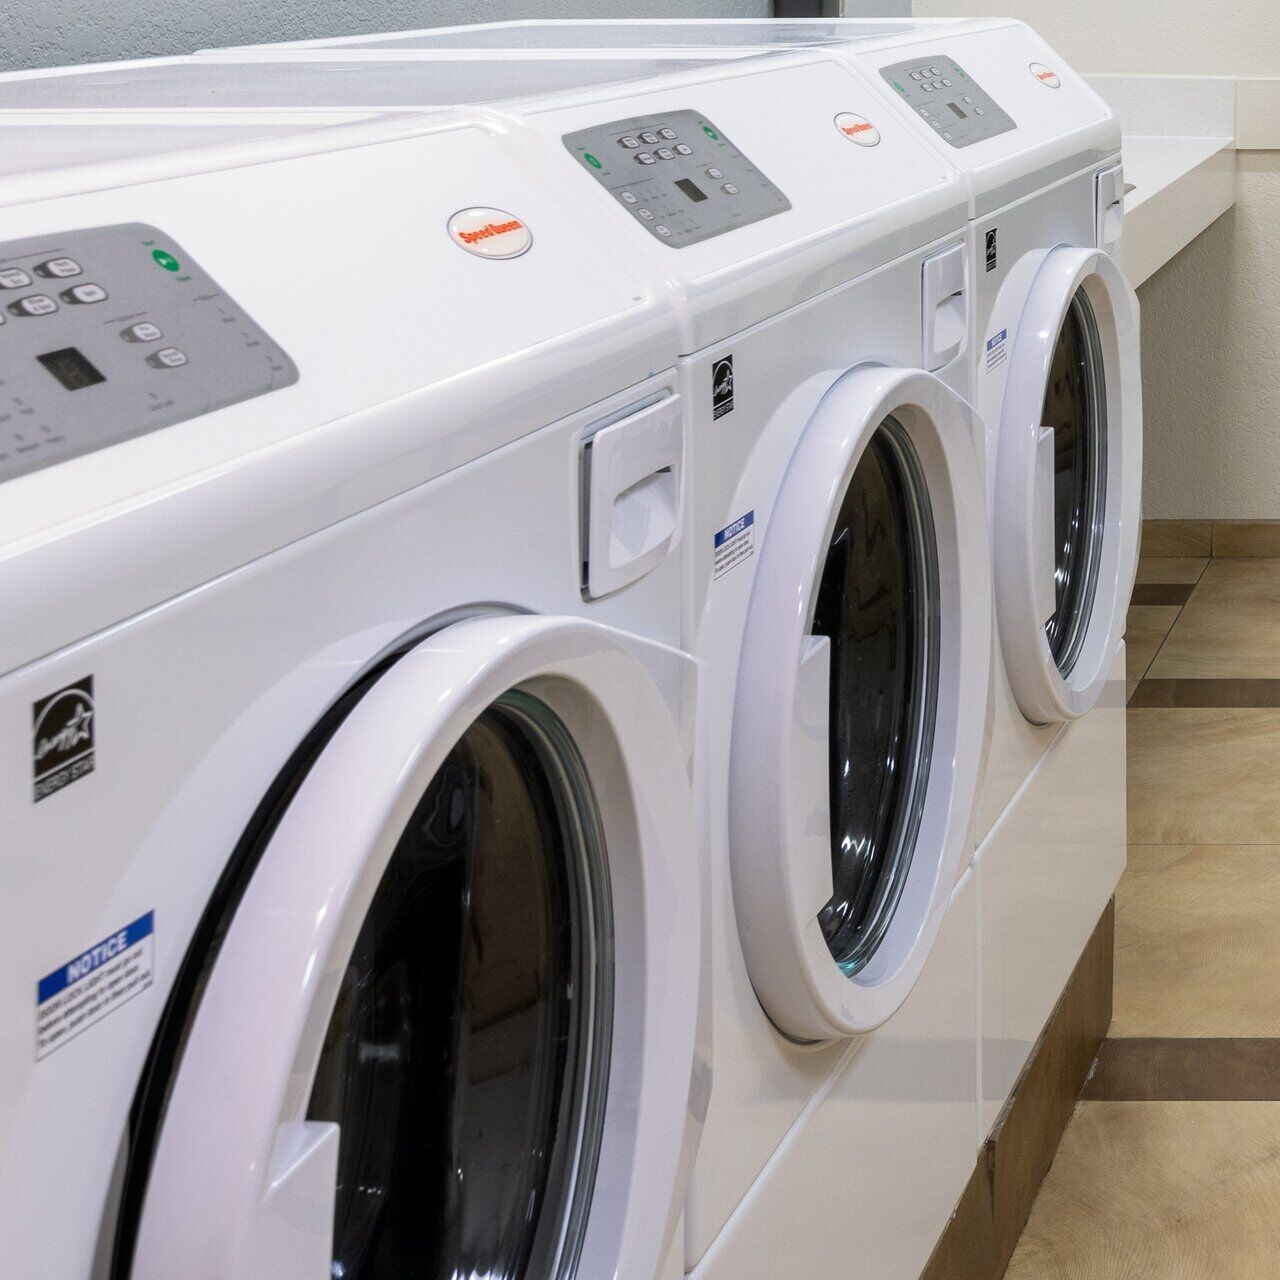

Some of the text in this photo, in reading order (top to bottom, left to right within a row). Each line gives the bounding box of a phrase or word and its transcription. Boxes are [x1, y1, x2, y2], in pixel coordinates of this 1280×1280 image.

[459, 220, 523, 244] Speed Queen
[724, 517, 745, 541] NOTICE
[66, 930, 127, 985] NOTICE
